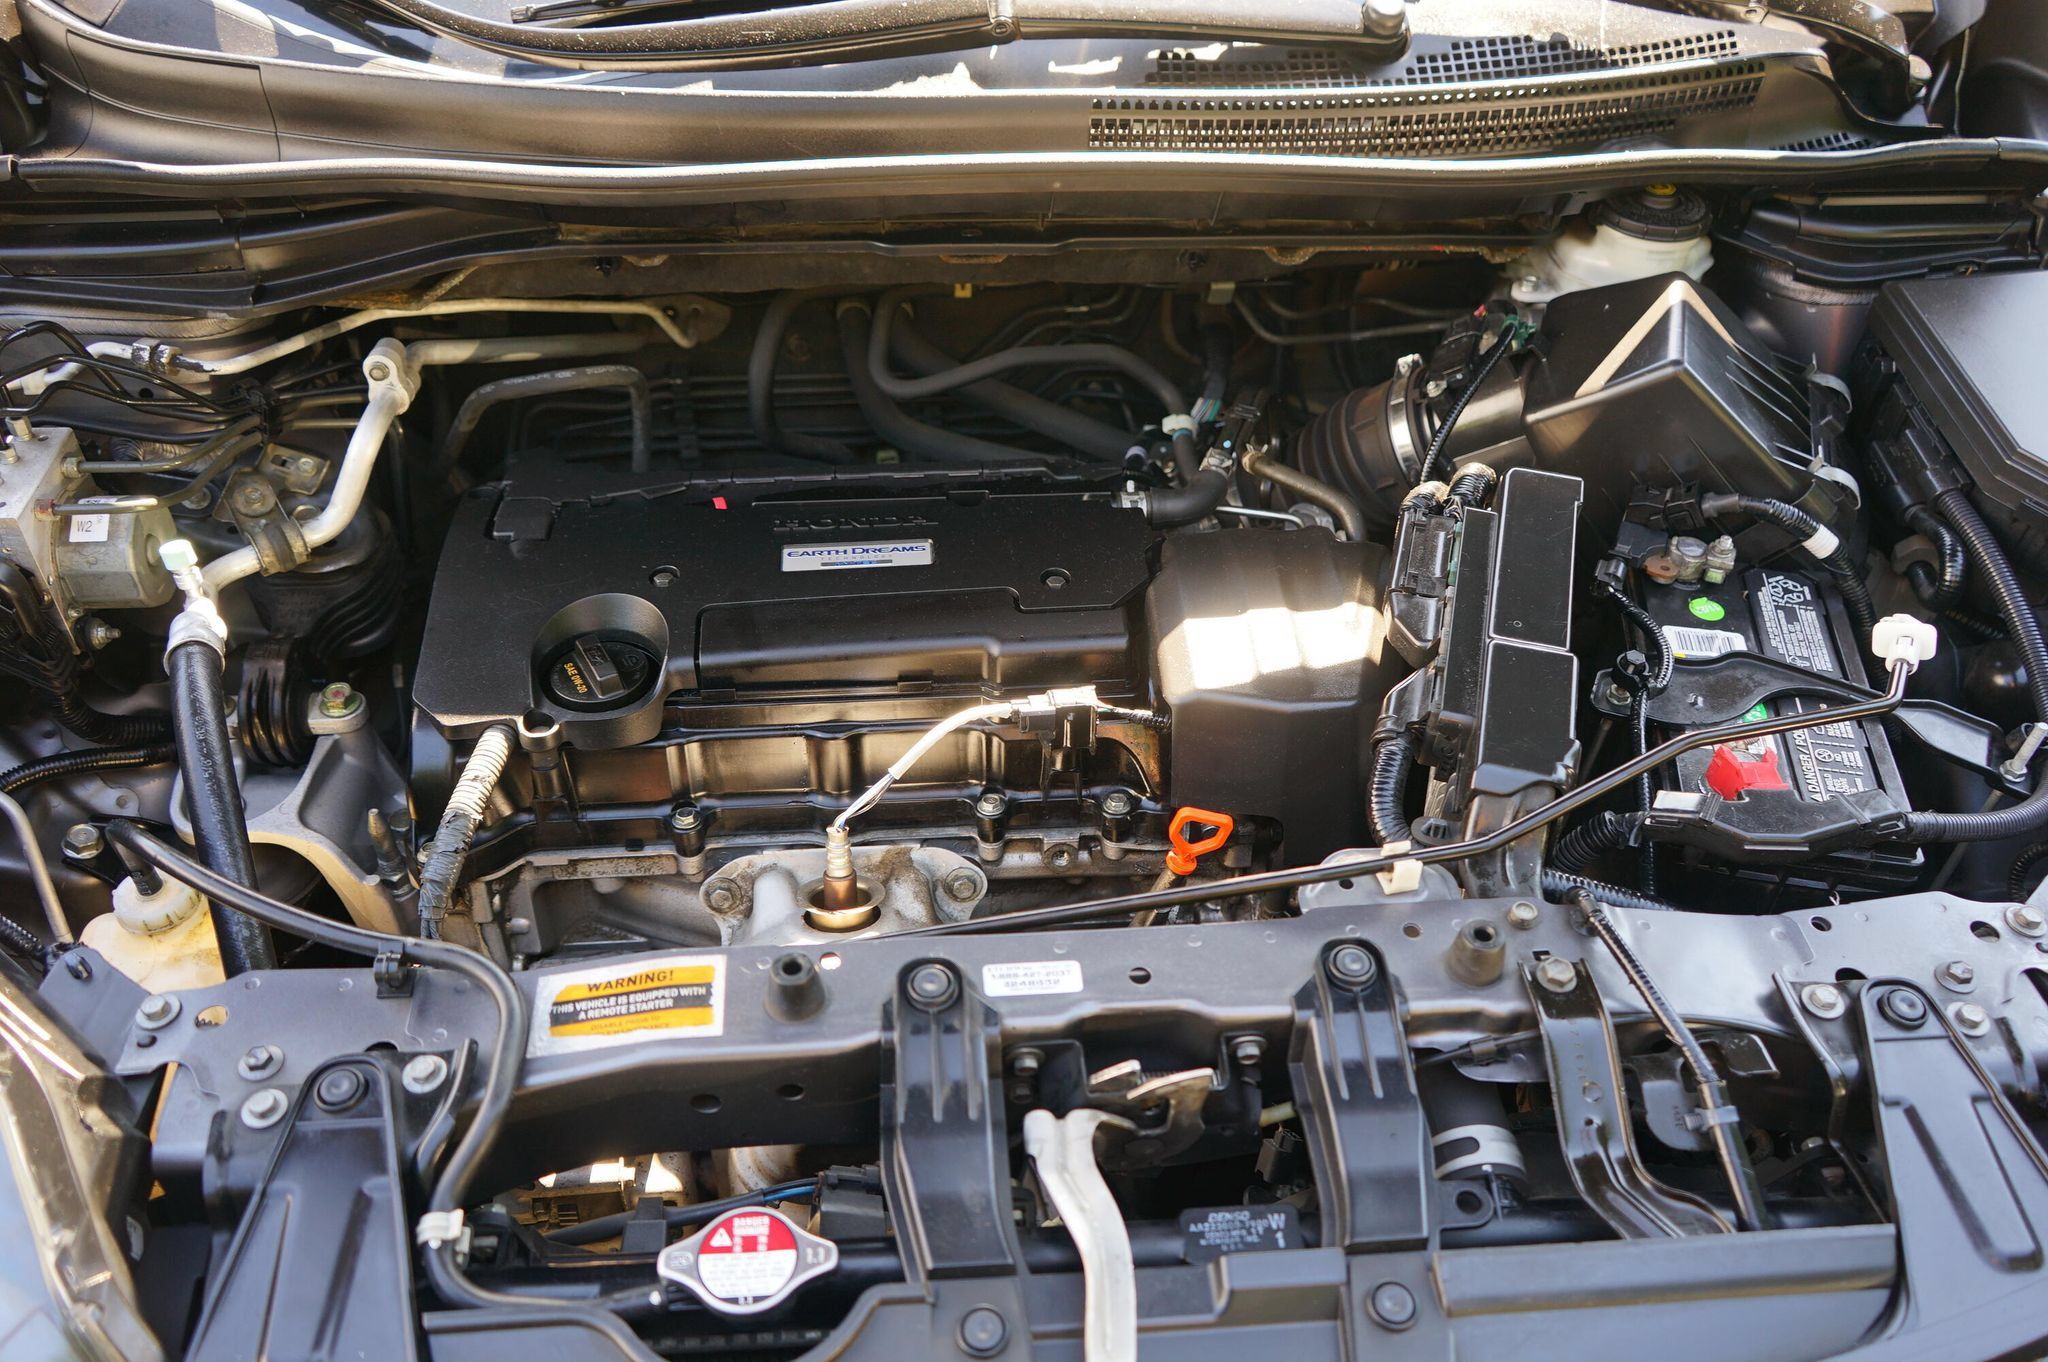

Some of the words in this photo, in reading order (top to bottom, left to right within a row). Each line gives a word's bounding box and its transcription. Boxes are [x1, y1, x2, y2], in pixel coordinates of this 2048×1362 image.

[77, 520, 93, 533] W2
[774, 515, 939, 531] HONDA
[787, 549, 848, 558] EARTH
[851, 545, 926, 555] DREAMS
[563, 662, 575, 676] SAE
[1799, 754, 1821, 793] DANGER
[587, 969, 675, 993] WARNING!
[552, 1003, 574, 1015] THIS
[575, 997, 617, 1011] VEHICLE
[618, 995, 628, 1005] IS
[629, 989, 679, 1003] EQUIPPED
[679, 986, 706, 997] WITH
[578, 1012, 587, 1021] A
[587, 1006, 628, 1019] REMOTE
[629, 999, 674, 1013] STARTER
[1208, 1211, 1251, 1222] DENSO
[1267, 1213, 1286, 1230] W
[1275, 1231, 1286, 1249] 1
